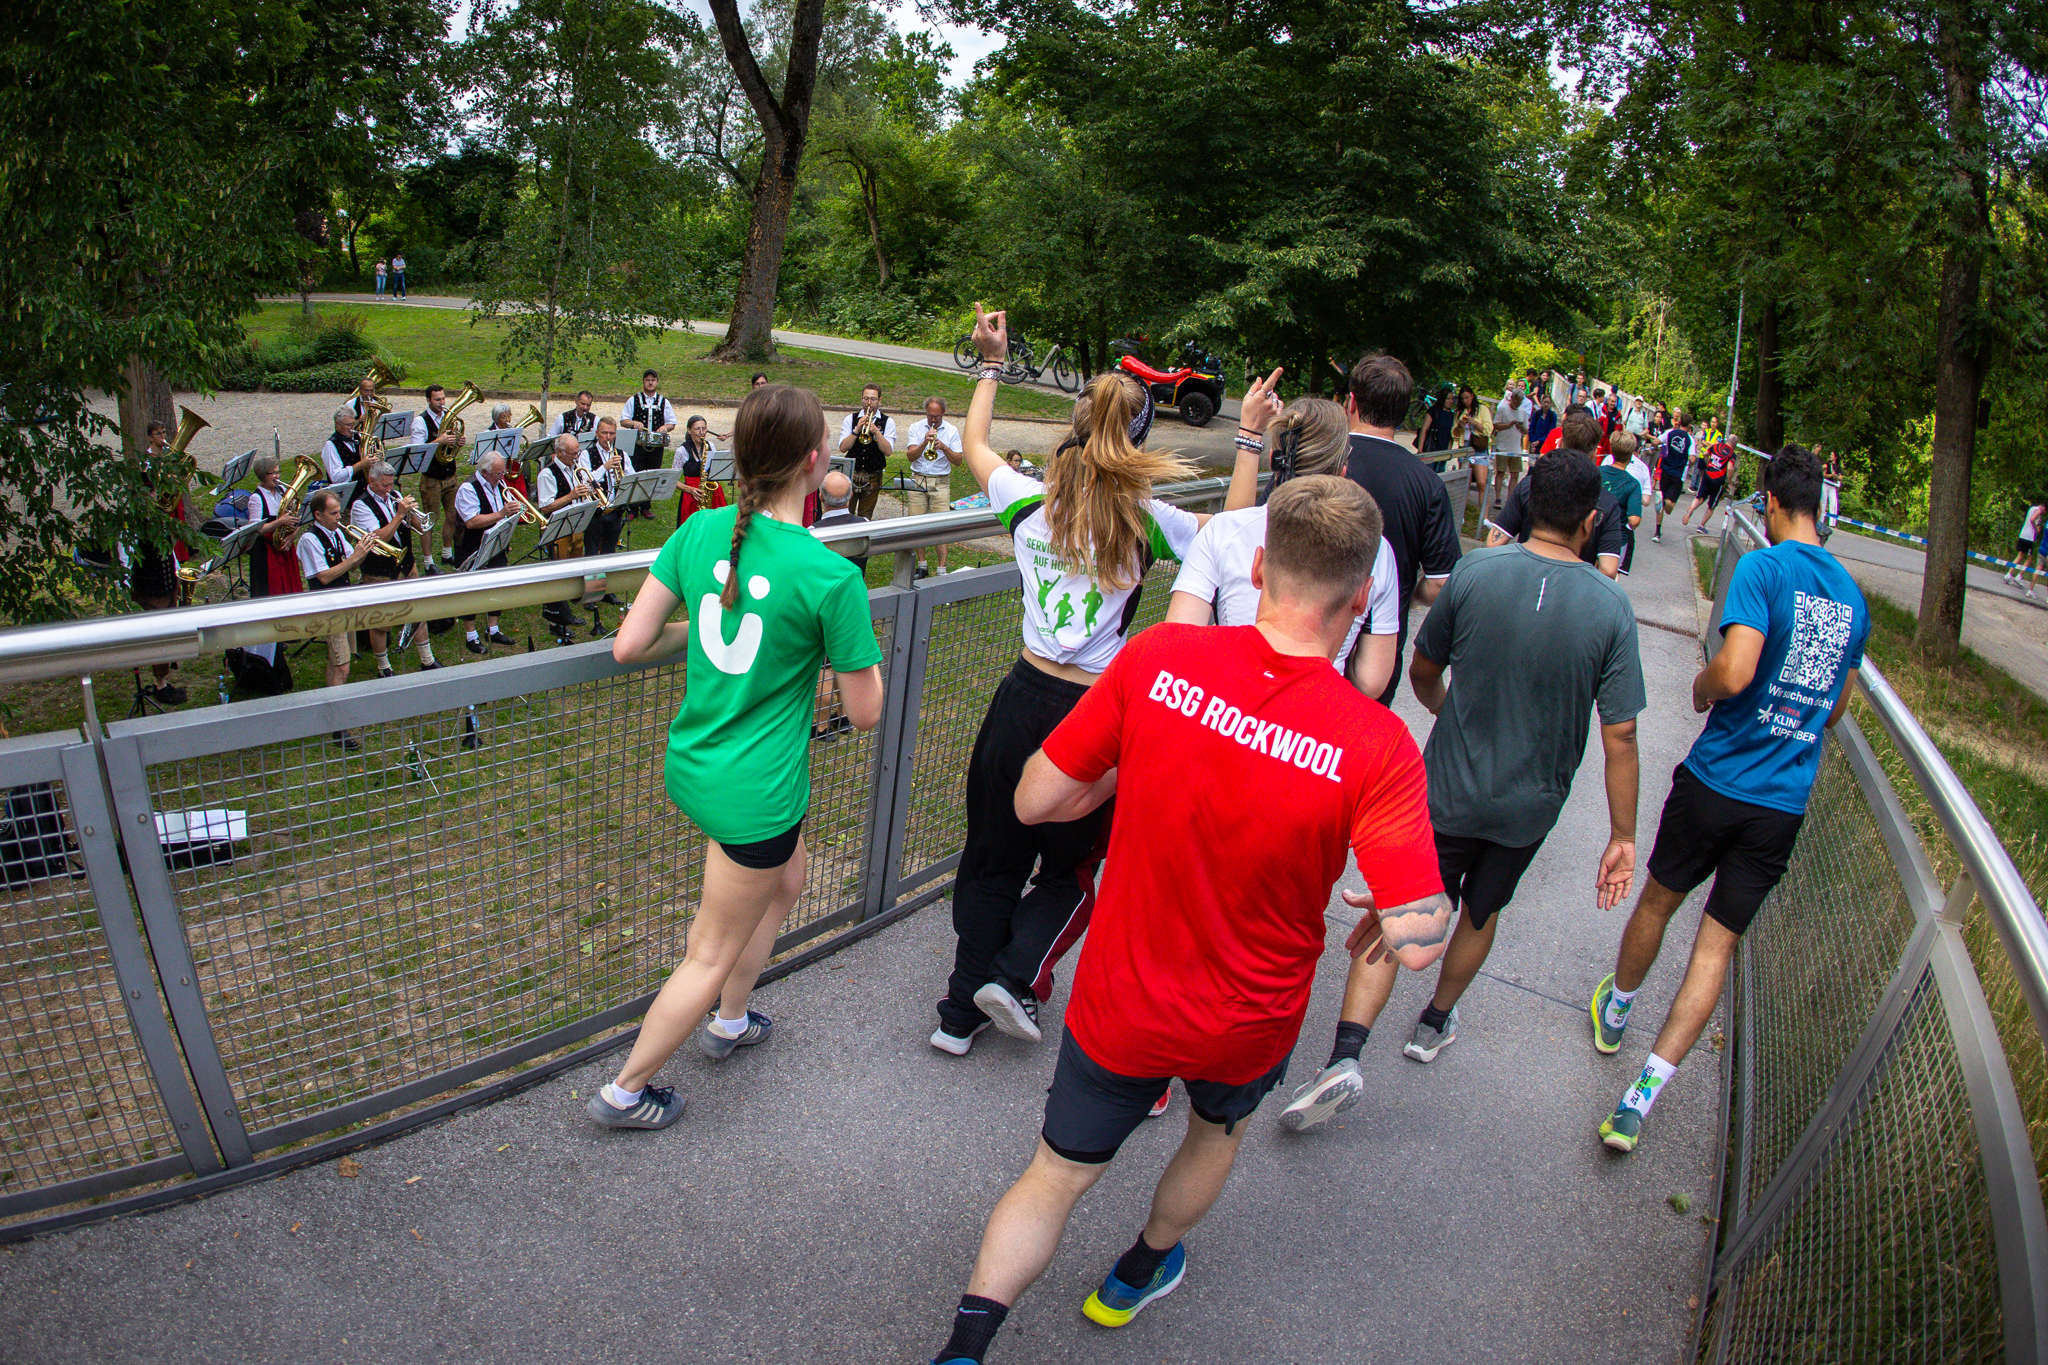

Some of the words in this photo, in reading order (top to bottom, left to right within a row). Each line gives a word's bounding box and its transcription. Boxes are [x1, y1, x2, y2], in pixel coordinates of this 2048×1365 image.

[1033, 554, 1049, 568] AUF
[1768, 682, 1784, 697] Wir
[1782, 690, 1814, 706] suchen
[1148, 670, 1204, 717] BSG
[1200, 695, 1343, 783] ROCKWOOL
[1770, 725, 1818, 744] KIPFNBER
